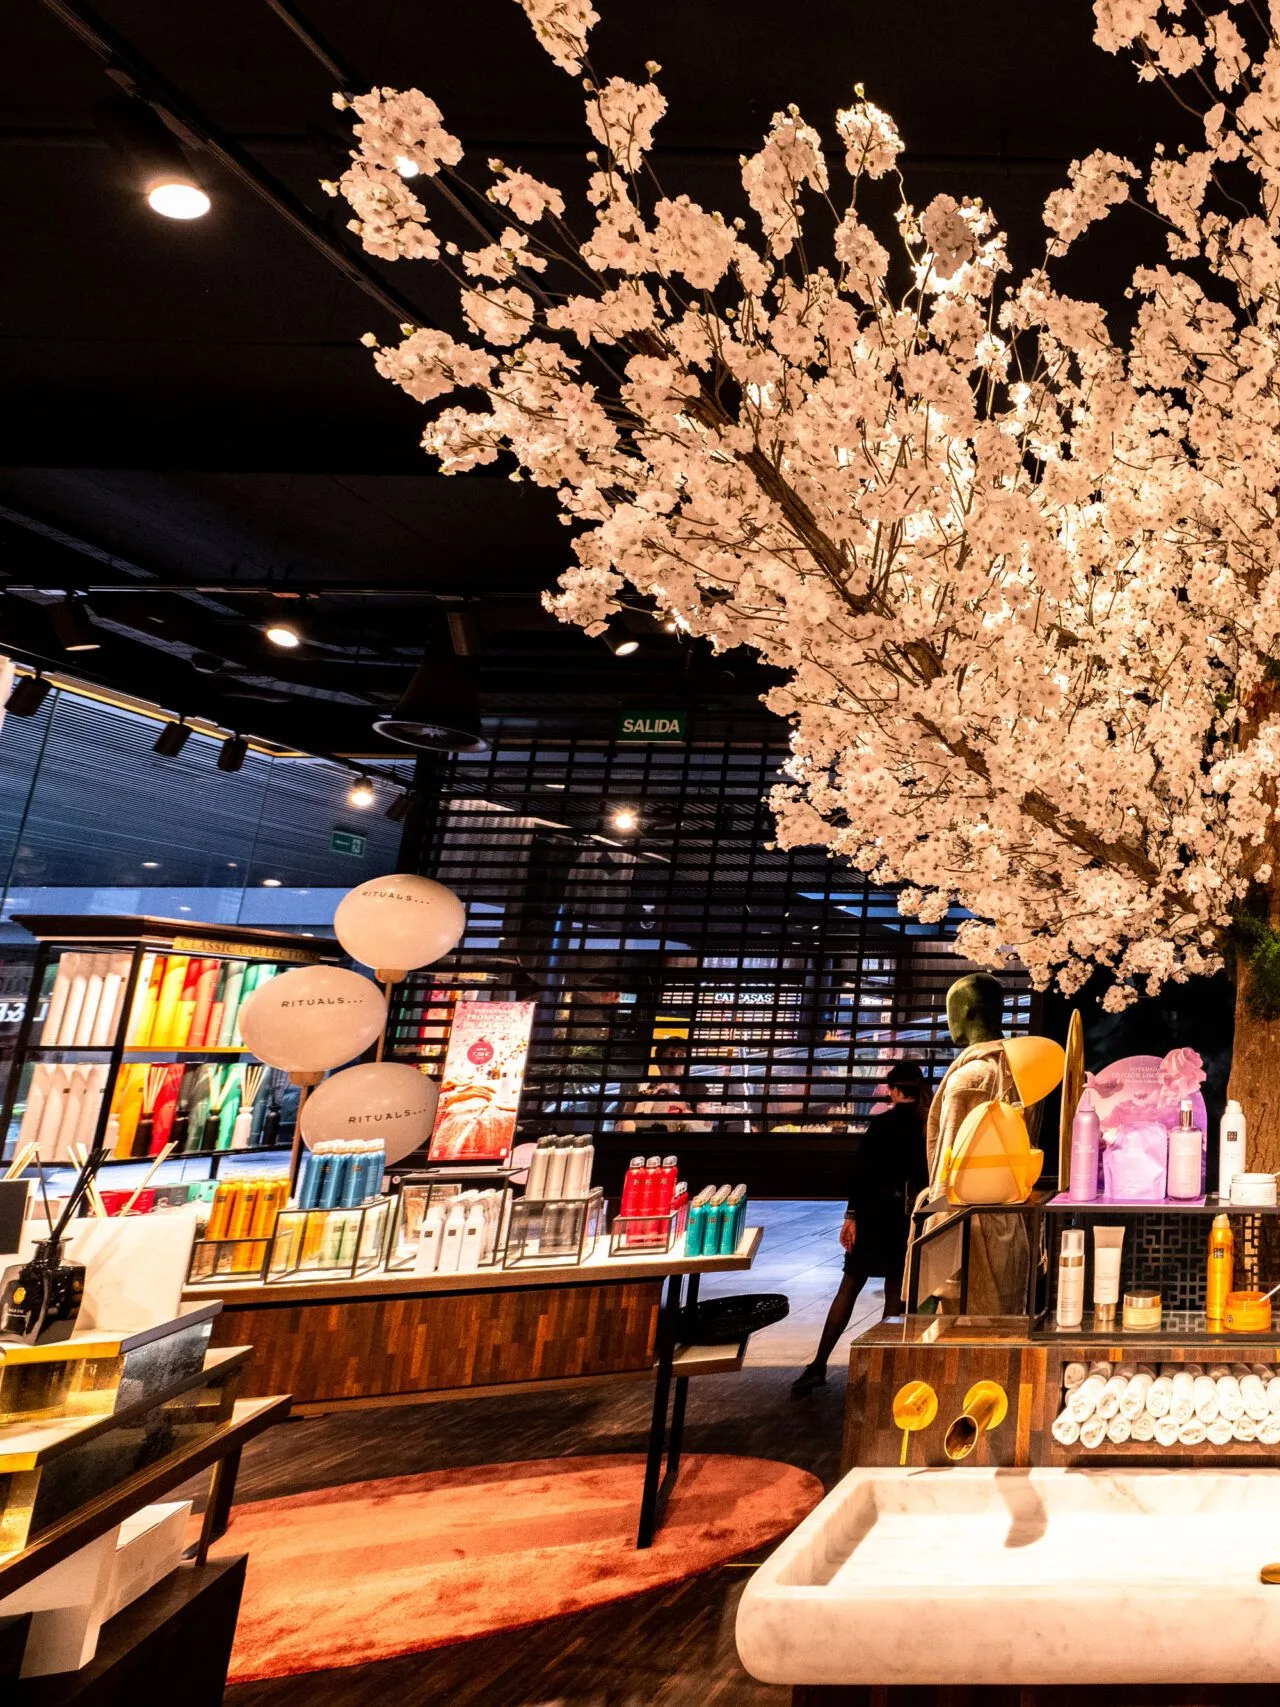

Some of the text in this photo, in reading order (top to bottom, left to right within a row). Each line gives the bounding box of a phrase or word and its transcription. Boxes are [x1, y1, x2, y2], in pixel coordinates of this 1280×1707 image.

[622, 719, 680, 733] SALIDA
[181, 938, 321, 963] CLASSIC COLLECTION
[281, 997, 363, 1008] RITUALS...
[348, 1109, 427, 1123] RITUALS...
